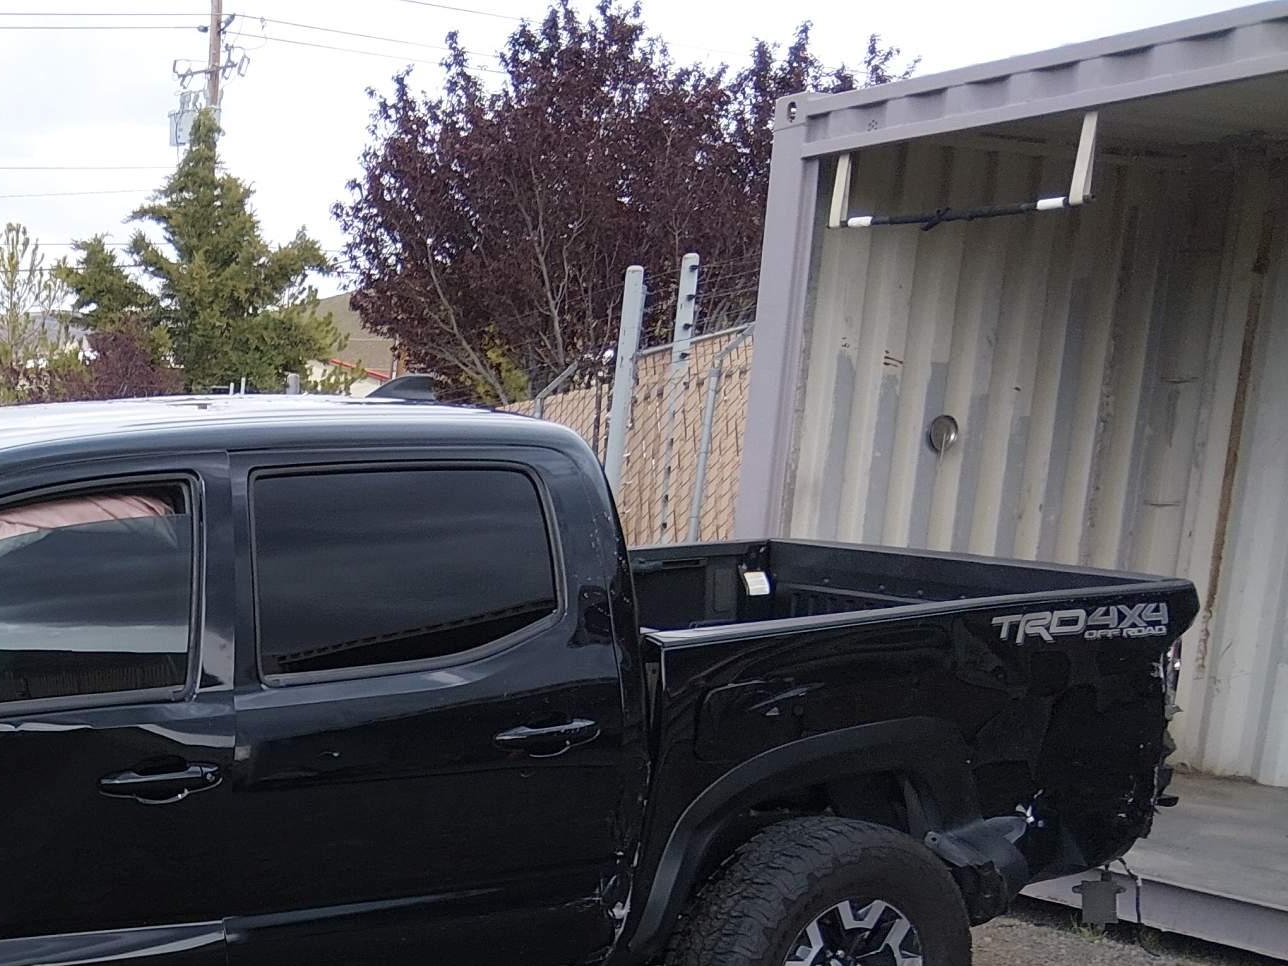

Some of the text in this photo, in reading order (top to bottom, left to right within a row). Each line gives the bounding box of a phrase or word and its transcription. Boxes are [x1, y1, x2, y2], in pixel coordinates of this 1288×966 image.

[992, 609, 1086, 646] TRD
[1083, 625, 1168, 640] OFF ROAD
